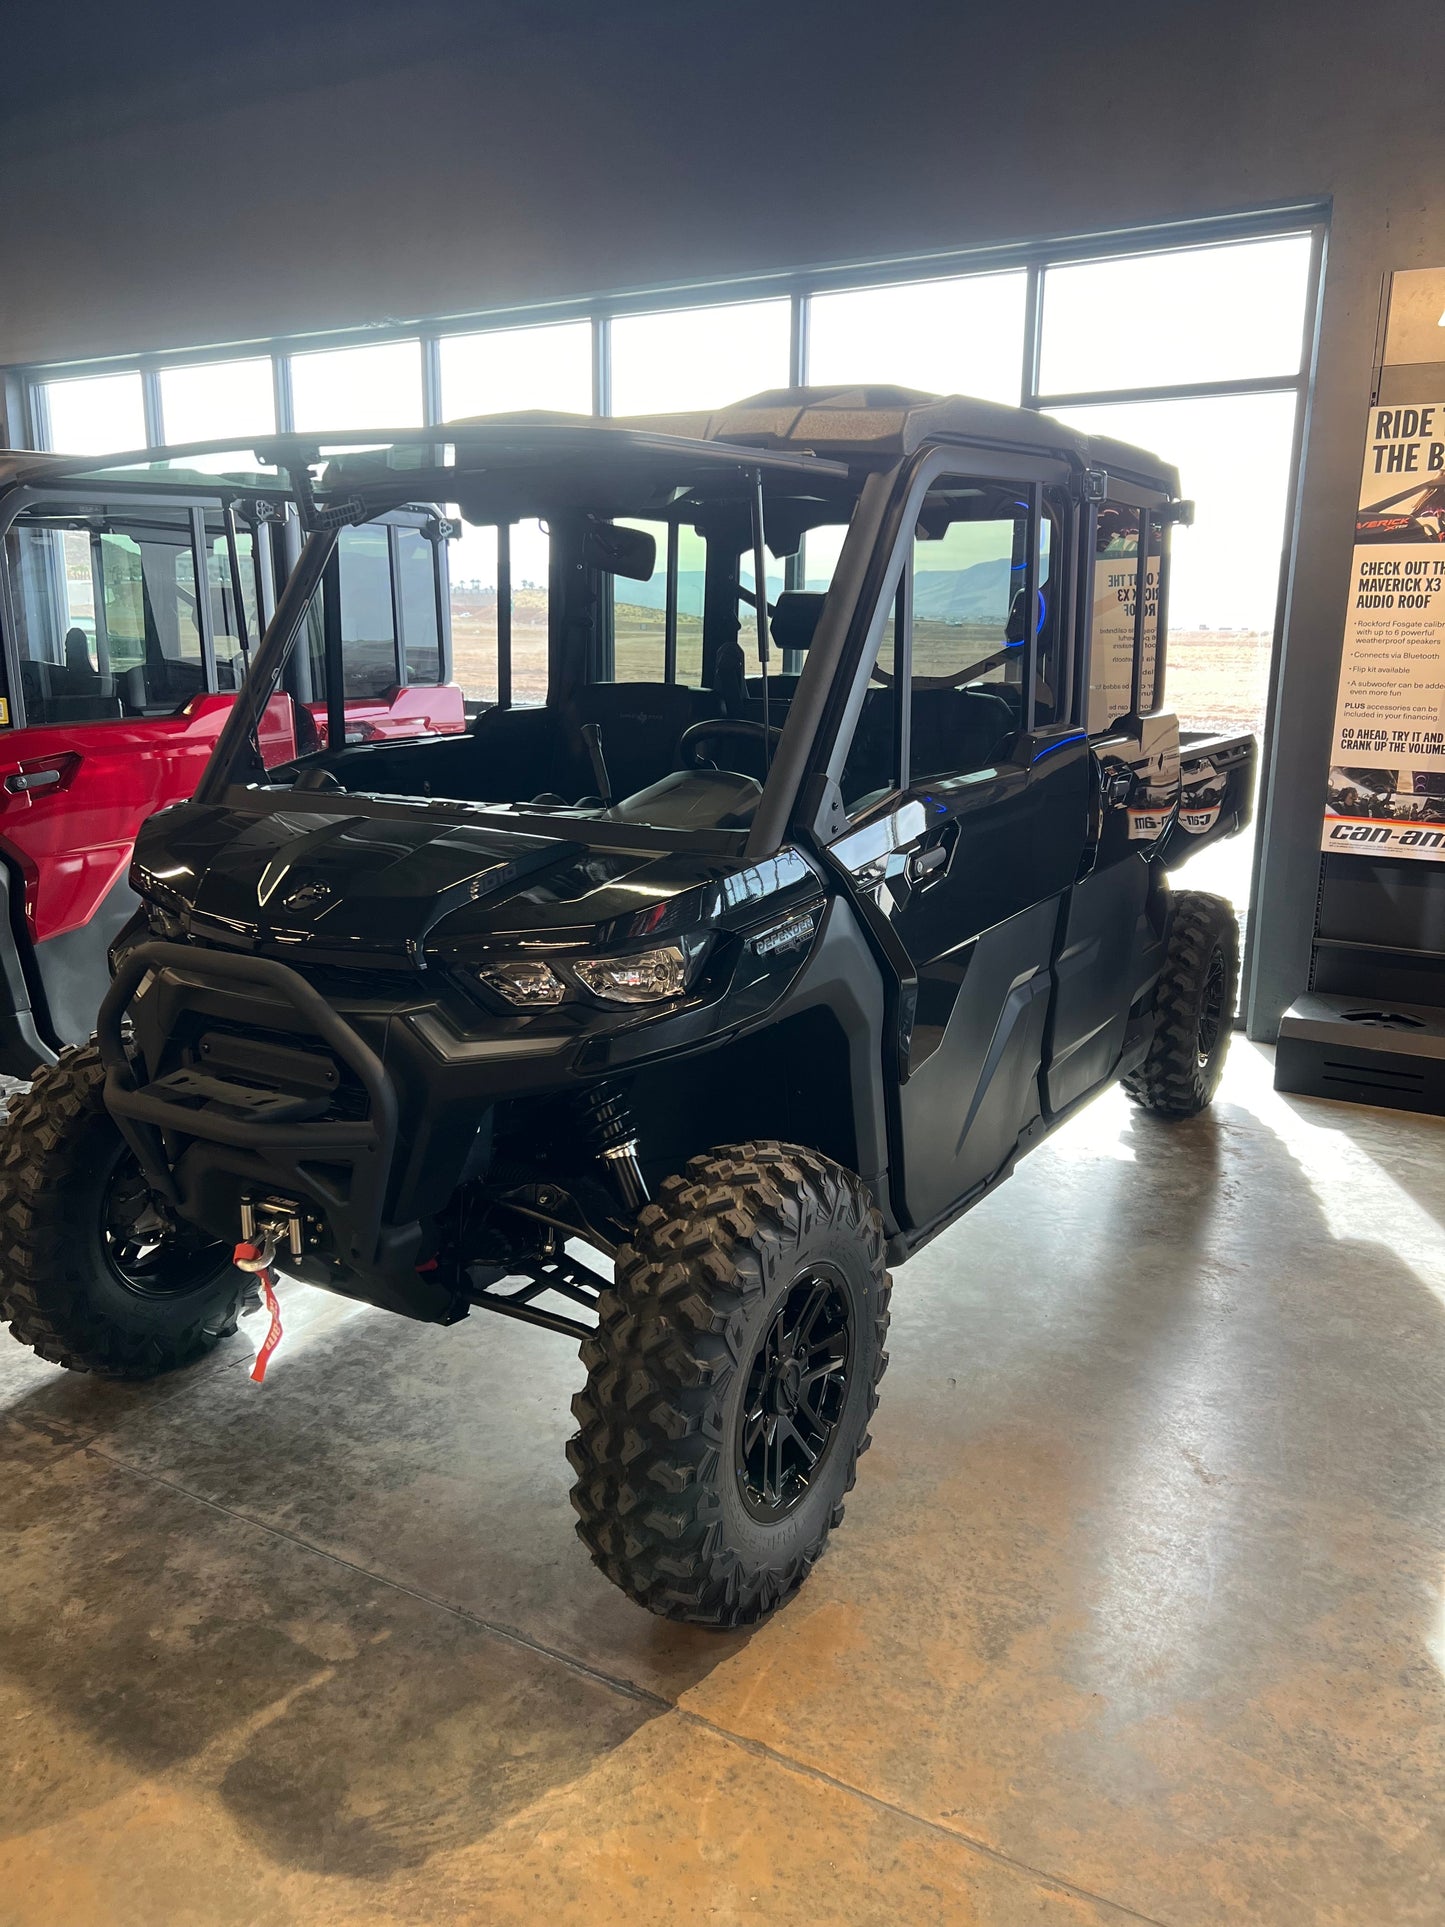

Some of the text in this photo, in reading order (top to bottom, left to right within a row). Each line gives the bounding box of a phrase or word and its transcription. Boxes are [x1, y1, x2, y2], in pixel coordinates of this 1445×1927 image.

[1375, 407, 1436, 440] RIDE
[1372, 443, 1421, 474] THE
[1360, 561, 1401, 576] CHECK
[1404, 560, 1430, 575] OUT
[1358, 577, 1442, 592] MAVERICK X3
[1355, 594, 1432, 609] AUDIO ROOF
[1357, 620, 1391, 628] Rockford
[1392, 620, 1423, 629] Fosgate
[1400, 629, 1435, 637] powerful
[1355, 637, 1441, 646] weatherproof speakers
[1353, 651, 1440, 660] Connects via Bluetooth
[1352, 665, 1366, 674] Flip
[1377, 666, 1411, 674] available
[1358, 680, 1397, 689] subwoofer
[1344, 702, 1366, 710] PLUS
[1366, 704, 1411, 712] accessories
[1427, 705, 1438, 713] be
[1343, 710, 1375, 719] included
[1384, 713, 1401, 721] your
[1341, 728, 1444, 743] GO AHEAD, TRY IT AND
[1340, 739, 1445, 755] CRANK UP THE VOLUME
[755, 917, 814, 952] DEFENDER
